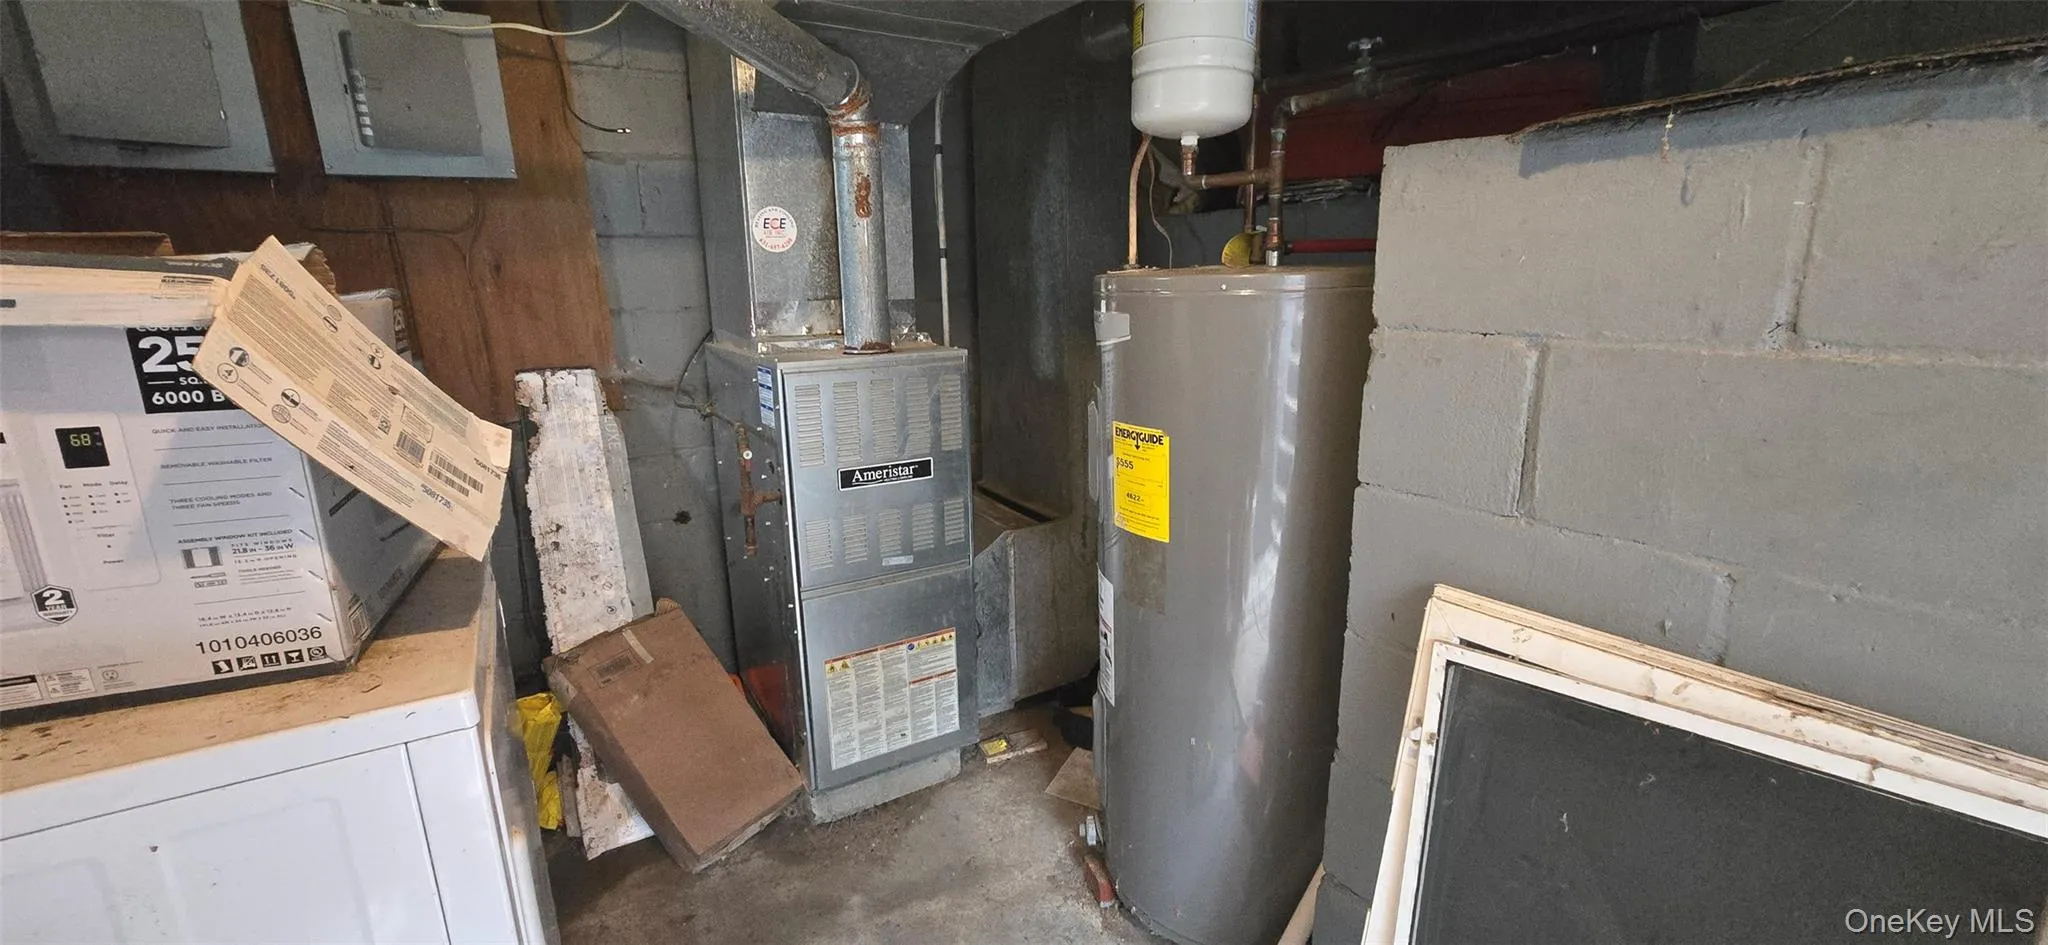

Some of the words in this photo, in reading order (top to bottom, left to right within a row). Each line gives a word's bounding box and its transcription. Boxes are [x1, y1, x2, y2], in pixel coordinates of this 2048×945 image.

[763, 218, 786, 229] ECE
[152, 391, 204, 405] 6000
[69, 433, 92, 447] 68
[852, 465, 915, 482] Ameristar
[194, 494, 228, 502] COOLING
[42, 589, 65, 606] 2
[195, 626, 322, 655] 1010406036
